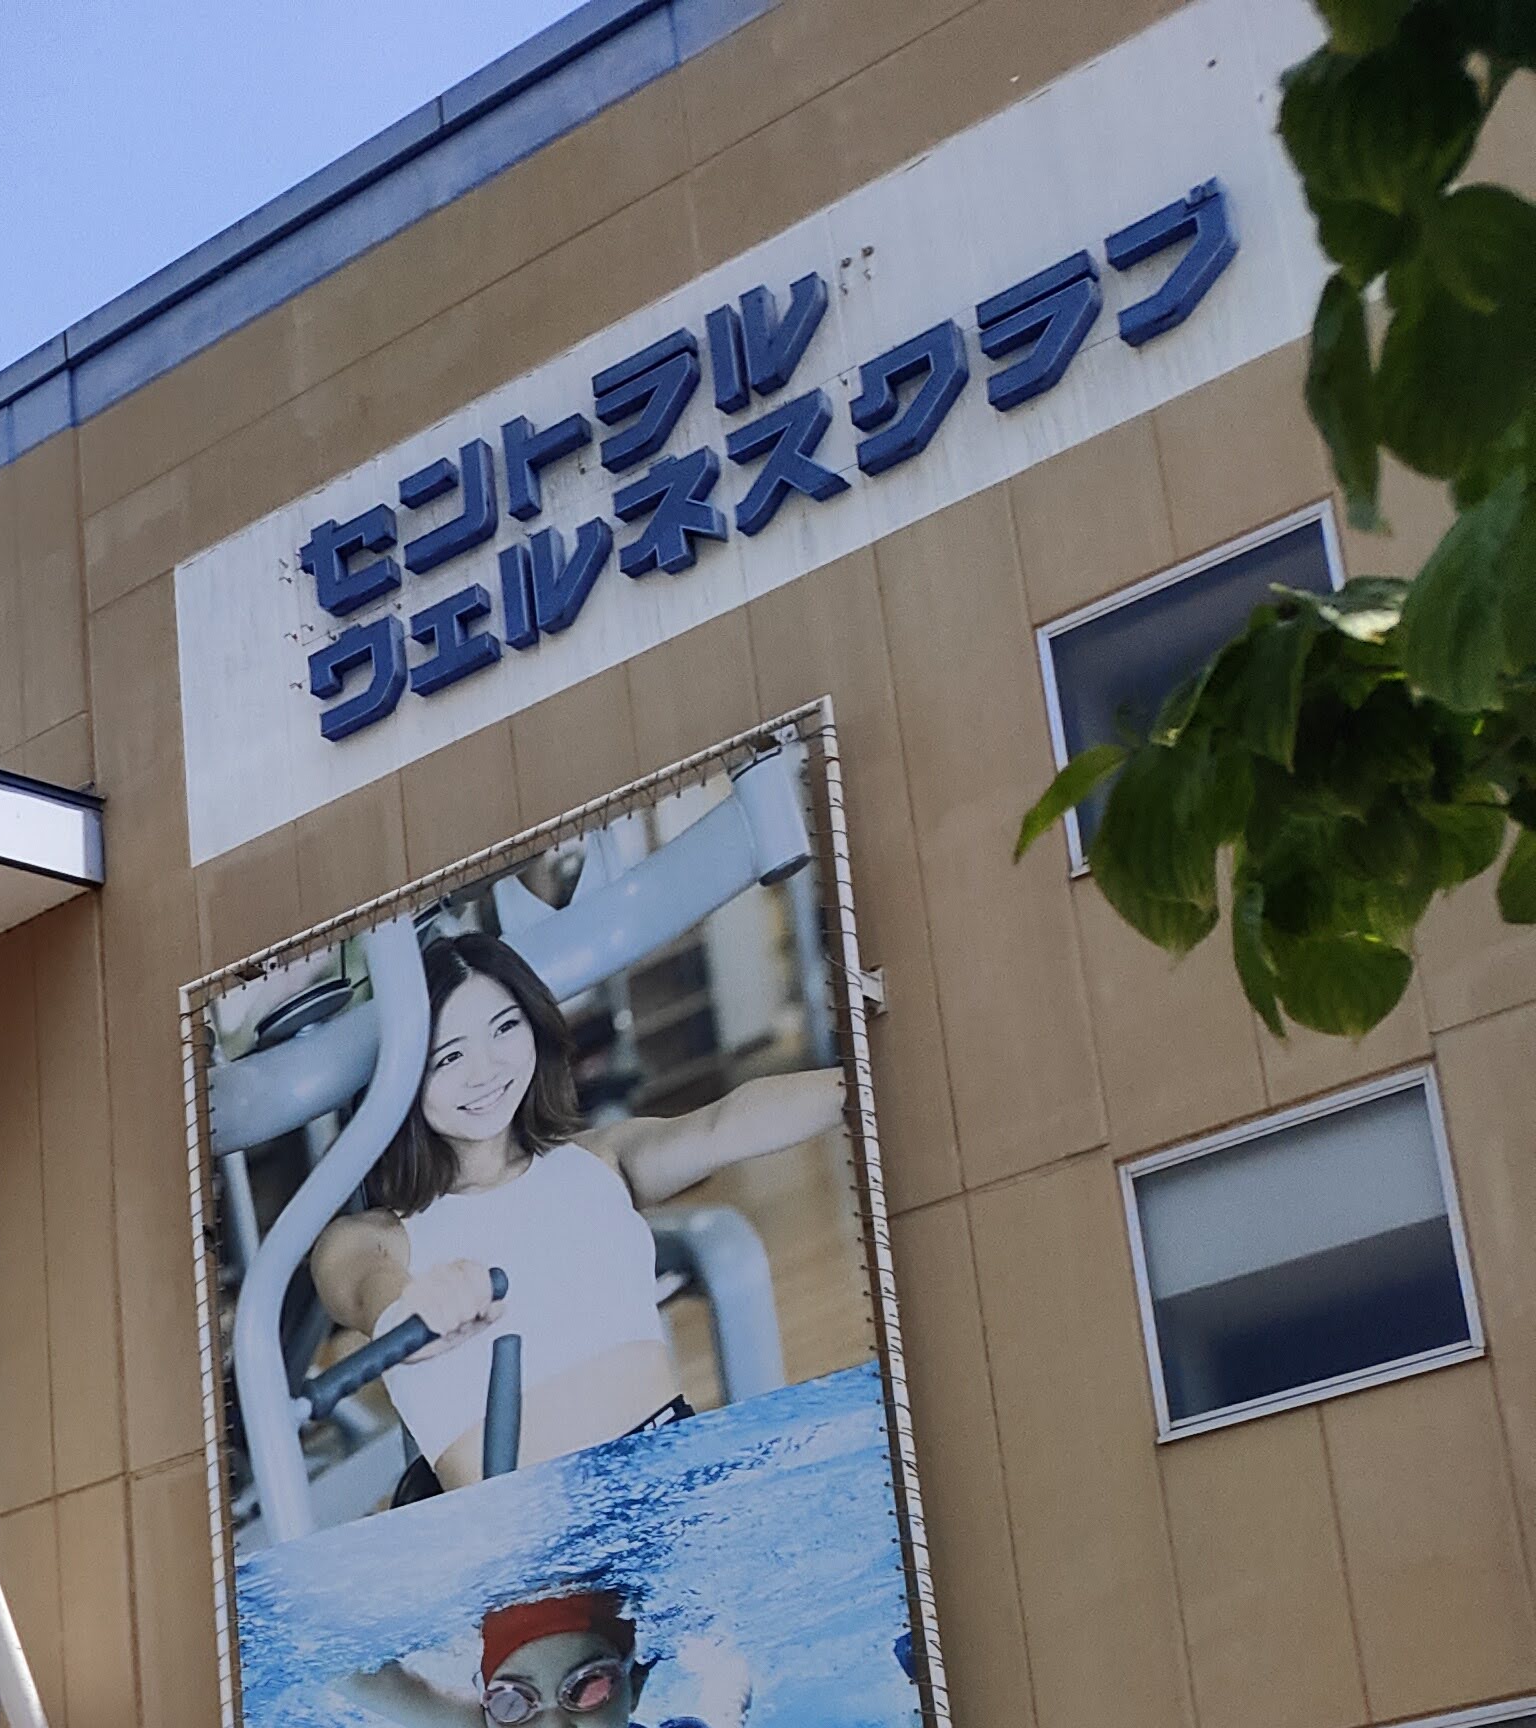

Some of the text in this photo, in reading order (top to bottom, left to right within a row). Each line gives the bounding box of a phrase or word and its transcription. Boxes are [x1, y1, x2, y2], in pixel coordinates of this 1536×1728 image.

[298, 270, 828, 617] セントラル
[308, 176, 1239, 743] ウェルネスクラブ
